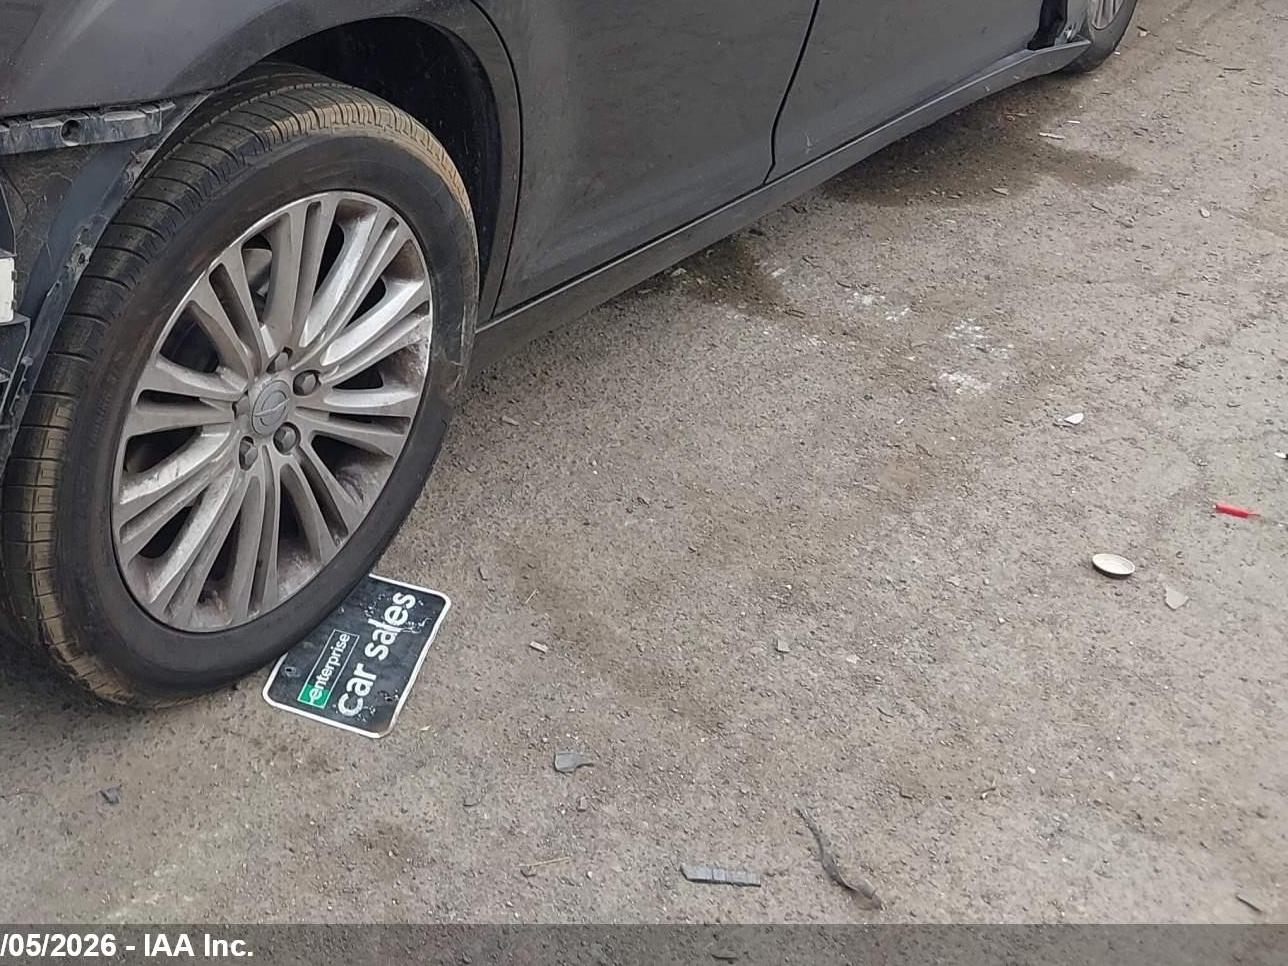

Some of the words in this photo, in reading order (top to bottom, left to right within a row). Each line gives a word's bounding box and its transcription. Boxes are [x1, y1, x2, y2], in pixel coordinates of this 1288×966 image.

[306, 631, 351, 706] enterprise
[337, 663, 378, 718] car
[364, 591, 417, 662] sales
